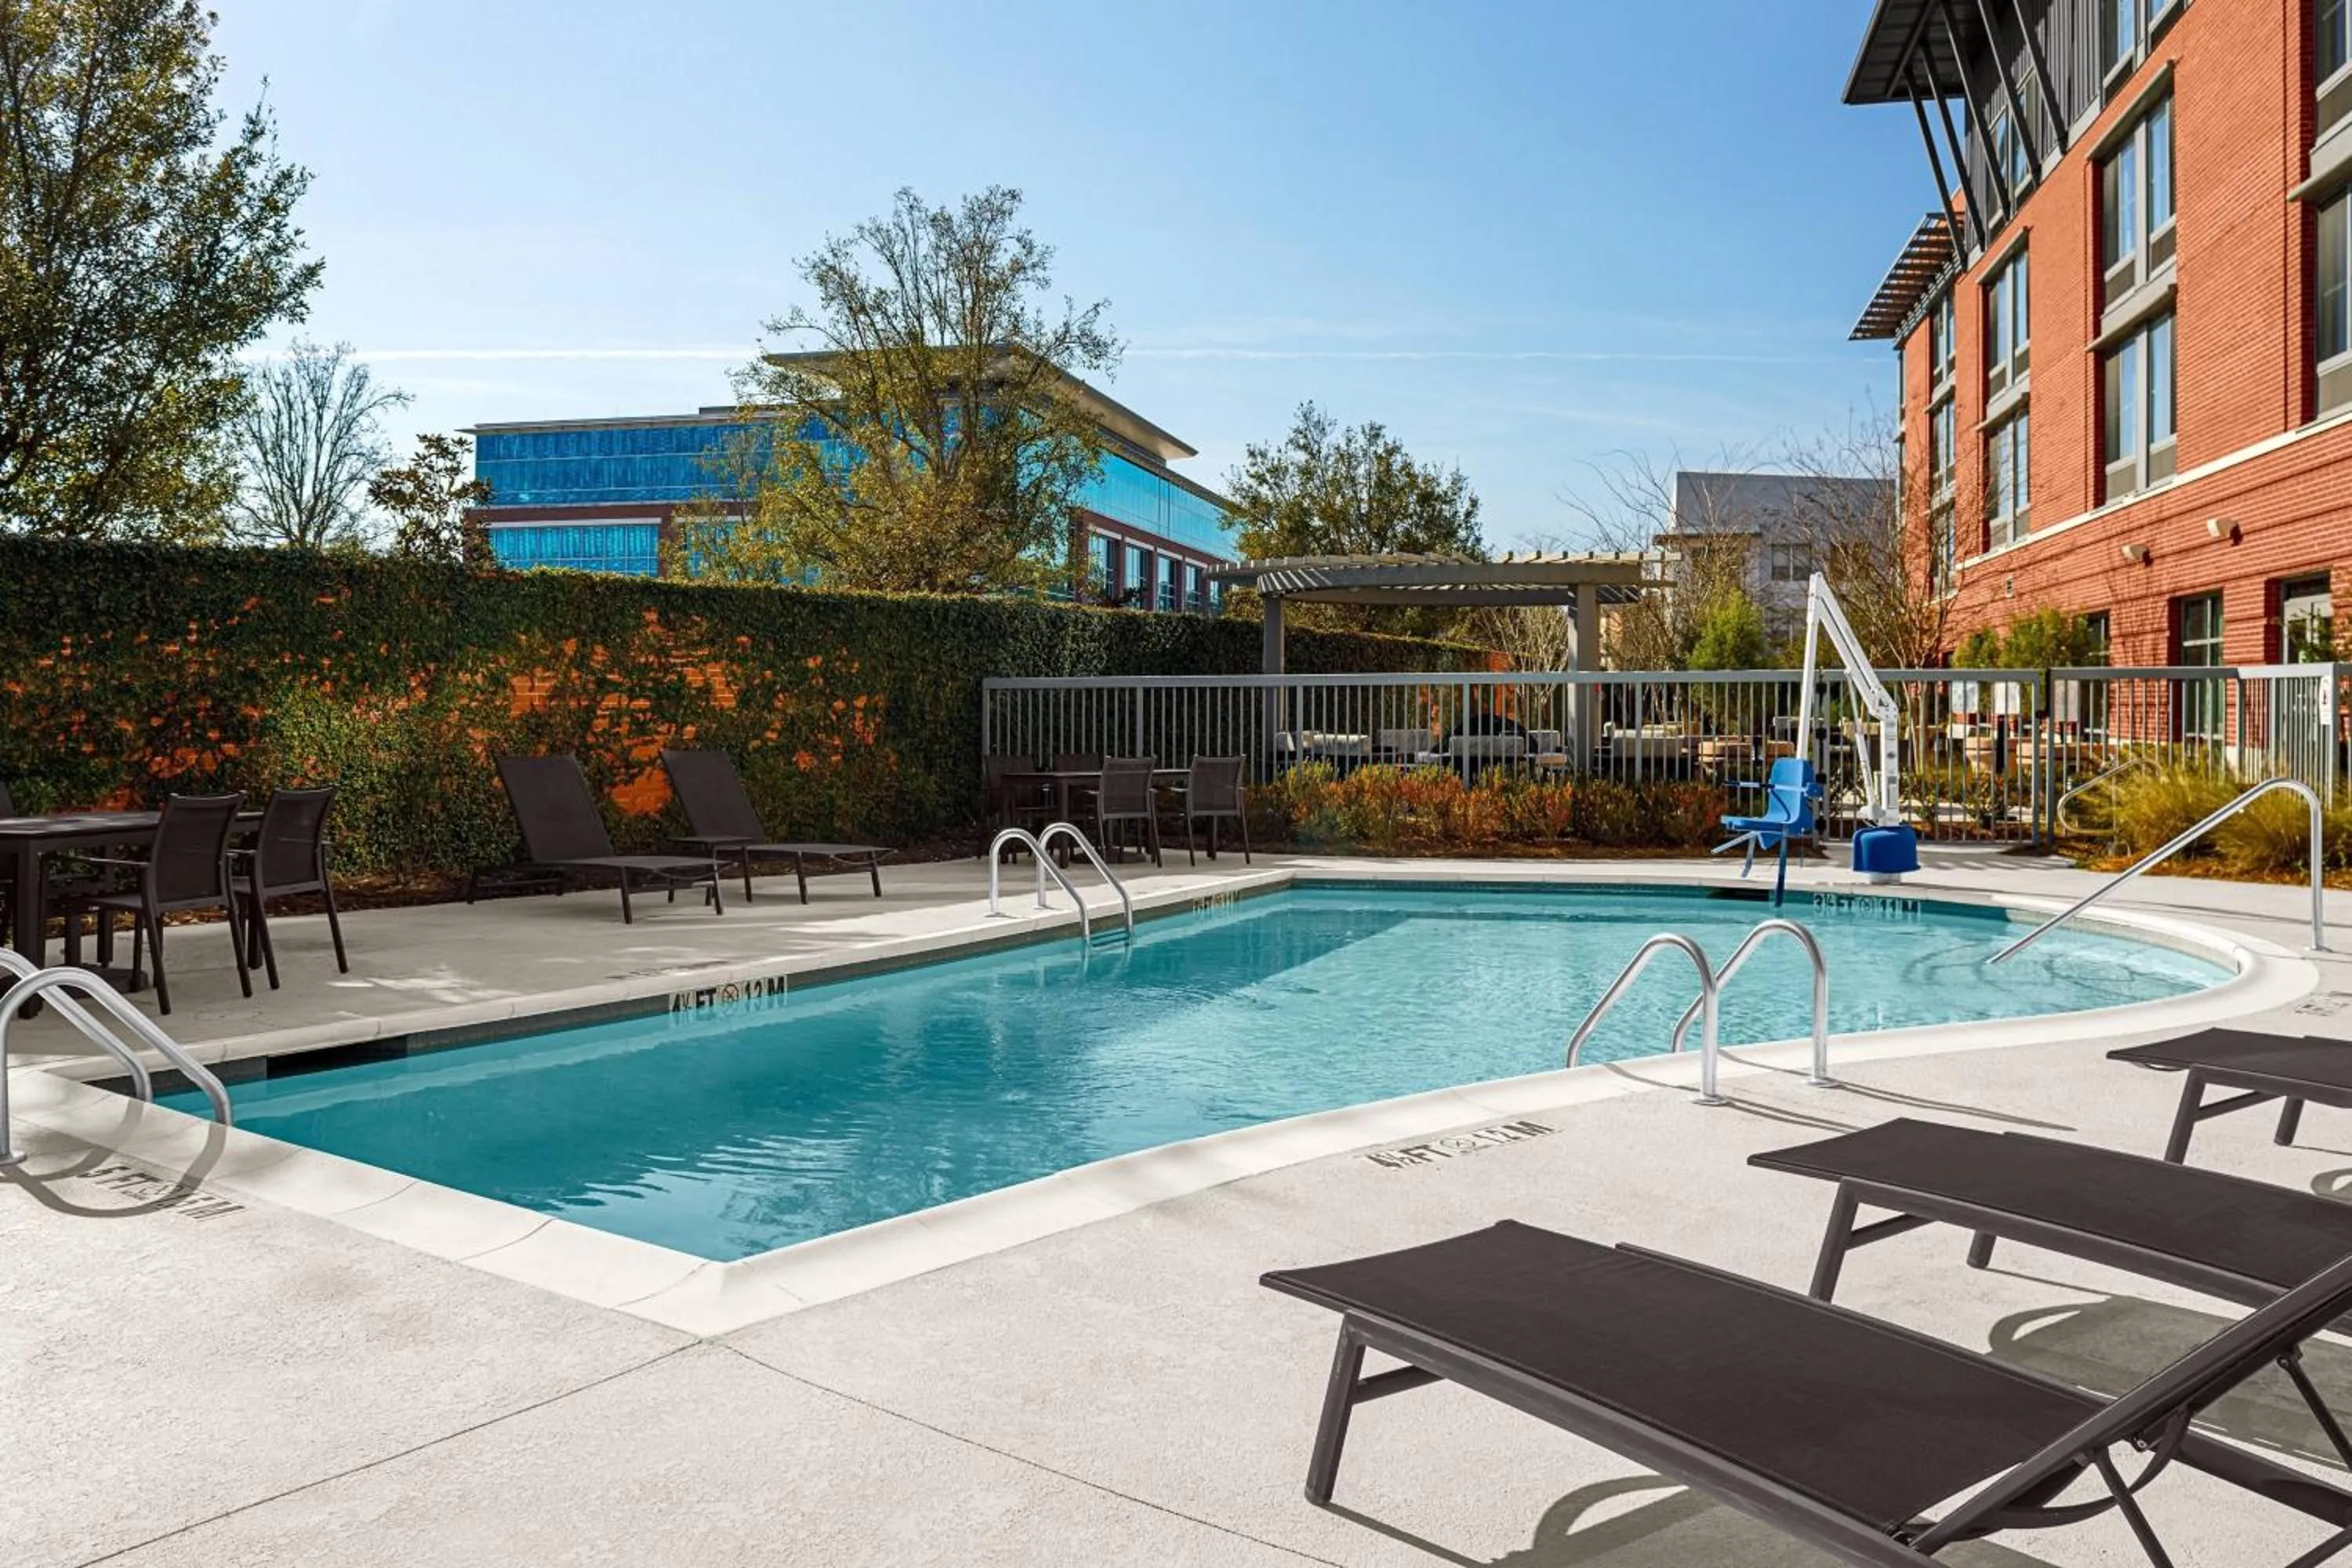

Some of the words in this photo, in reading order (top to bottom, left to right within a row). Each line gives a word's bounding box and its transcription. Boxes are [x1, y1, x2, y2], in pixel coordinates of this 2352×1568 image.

[695, 986, 717, 1007] FT
[768, 976, 785, 996] M
[1399, 1145, 1452, 1163] FT
[1501, 1120, 1555, 1138] M
